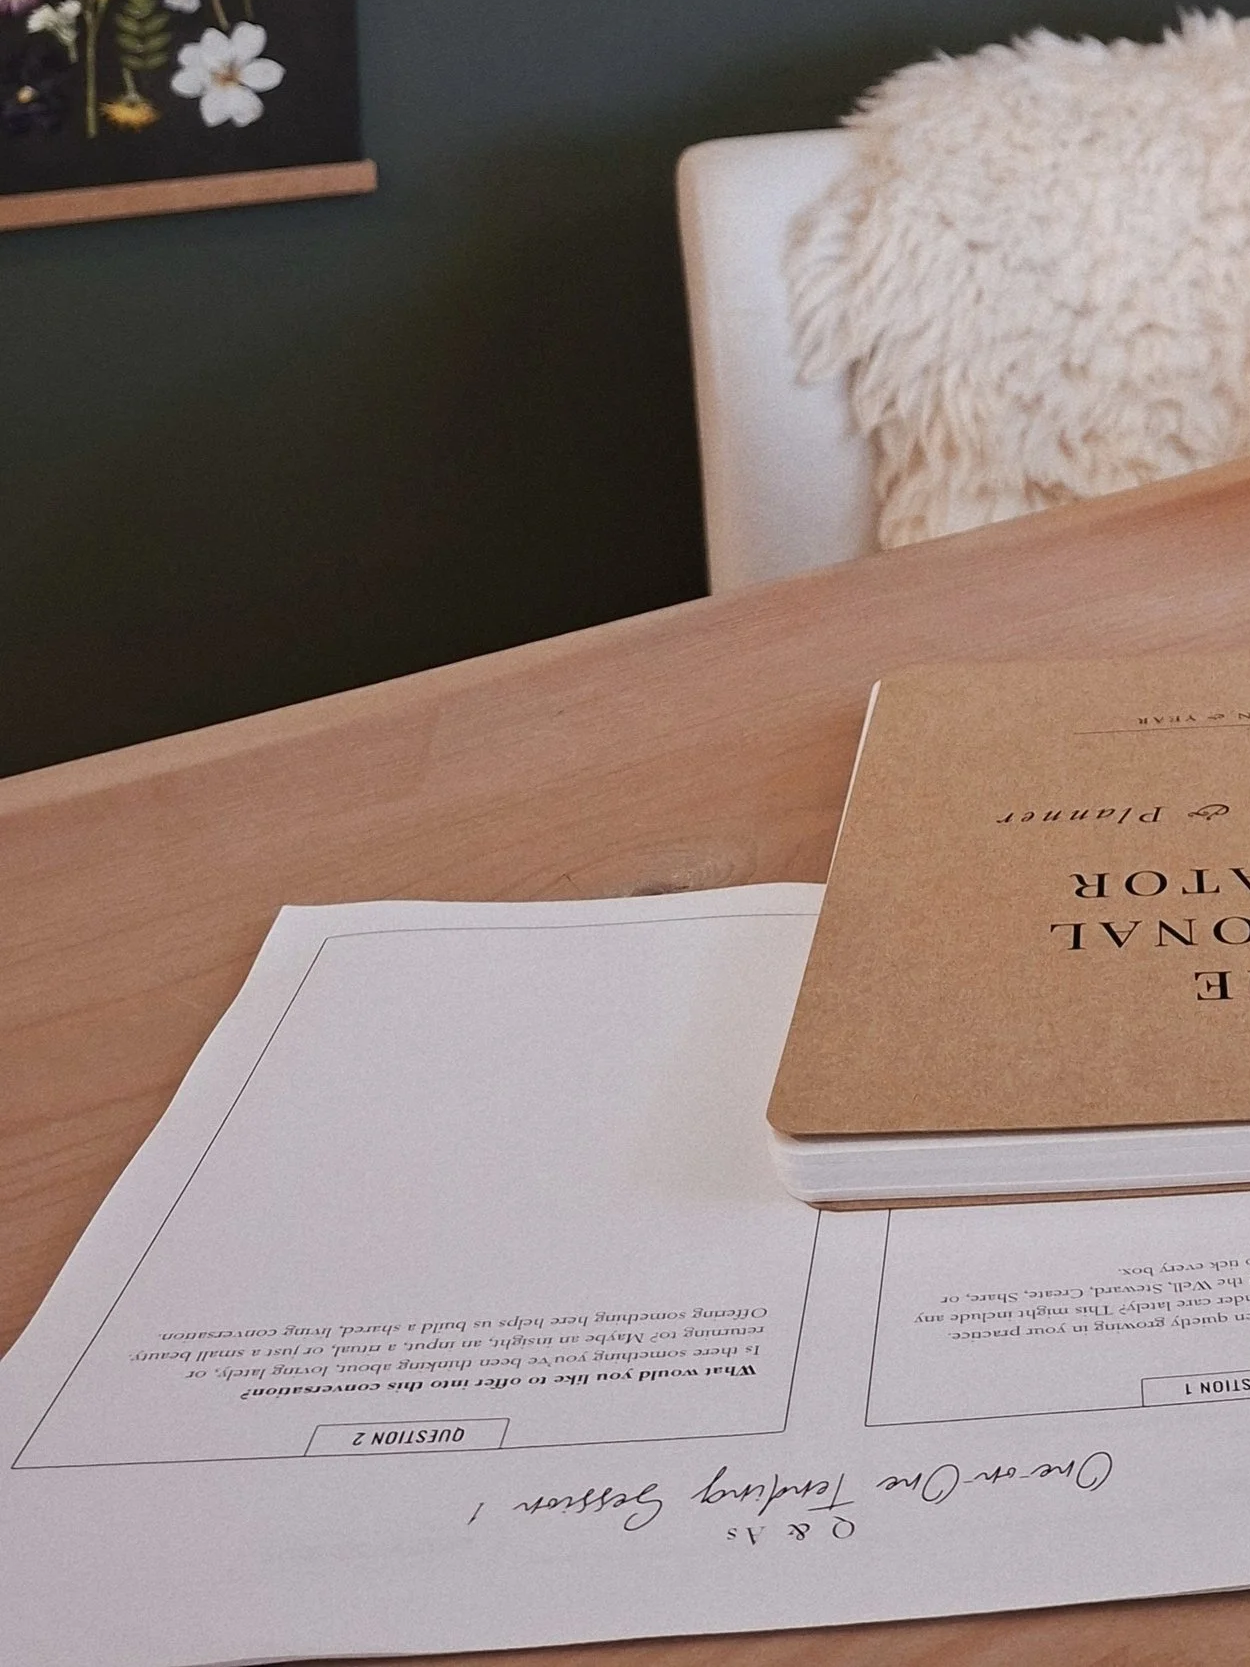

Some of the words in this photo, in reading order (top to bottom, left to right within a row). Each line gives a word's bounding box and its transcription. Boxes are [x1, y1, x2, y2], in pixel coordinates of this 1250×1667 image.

[1138, 714, 1197, 725] YEAR
[1207, 713, 1226, 721] &
[996, 806, 1162, 825] Planner
[1187, 803, 1230, 821] &
[1117, 1266, 1154, 1278] box.
[1159, 1262, 1205, 1274] every
[1209, 1259, 1240, 1272] tick
[1167, 1280, 1213, 1294] Well,
[1217, 1276, 1244, 1289] the
[965, 1292, 1019, 1304] Share,
[1023, 1288, 1084, 1300] Create,
[1089, 1283, 1163, 1299] Steward,
[940, 1295, 960, 1304] or
[1176, 1298, 1212, 1308] care
[691, 1307, 768, 1321] Offering
[1018, 1305, 1069, 1320] might
[1074, 1304, 1114, 1317] This
[1118, 1300, 1171, 1316] lately?
[473, 1320, 492, 1329] us
[498, 1315, 545, 1331] helps
[550, 1315, 589, 1328] here
[594, 1311, 687, 1326] something
[913, 1311, 945, 1324] any
[949, 1310, 1013, 1325] include
[1093, 1316, 1166, 1332] growing
[1170, 1311, 1229, 1330] quietly
[158, 1328, 278, 1341] conversation.
[282, 1324, 333, 1339] living
[338, 1324, 402, 1339] shared,
[407, 1323, 417, 1332] a
[420, 1321, 467, 1335] build
[683, 1325, 765, 1338] returning
[947, 1324, 1021, 1340] practice.
[1025, 1322, 1066, 1336] your
[1072, 1324, 1089, 1333] in
[461, 1339, 483, 1348] an
[488, 1334, 554, 1351] insight,
[559, 1335, 580, 1345] an
[584, 1330, 645, 1346] Maybe
[649, 1330, 677, 1344] to?
[302, 1346, 325, 1356] or
[331, 1344, 382, 1358] ritual,
[387, 1343, 398, 1352] a
[403, 1337, 456, 1352] input,
[745, 1344, 760, 1356] Is
[128, 1350, 193, 1363] beauty.
[195, 1349, 246, 1363] small
[251, 1348, 262, 1357] a
[265, 1344, 301, 1360] just
[592, 1349, 687, 1364] something
[692, 1346, 738, 1359] there
[270, 1363, 329, 1378] loving
[335, 1363, 393, 1376] about,
[396, 1358, 473, 1373] thinking
[479, 1357, 522, 1370] been
[704, 1364, 757, 1377] What
[185, 1370, 208, 1379] or
[214, 1365, 267, 1382] lately,
[527, 1375, 547, 1386] to
[553, 1373, 590, 1387] like
[596, 1367, 634, 1382] you
[637, 1368, 699, 1383] would
[386, 1380, 424, 1394] this
[429, 1378, 470, 1391] into
[474, 1376, 523, 1391] offer
[1184, 1382, 1192, 1396] 1
[239, 1382, 382, 1401] conversation?
[351, 1431, 366, 1447] 2
[370, 1426, 466, 1446] QUESTION
[876, 1451, 1113, 1505] One-on-One
[690, 1466, 854, 1516] Tending
[512, 1483, 663, 1531] Session
[787, 1522, 811, 1542] &
[831, 1515, 856, 1540] Q
[726, 1525, 766, 1546] As
